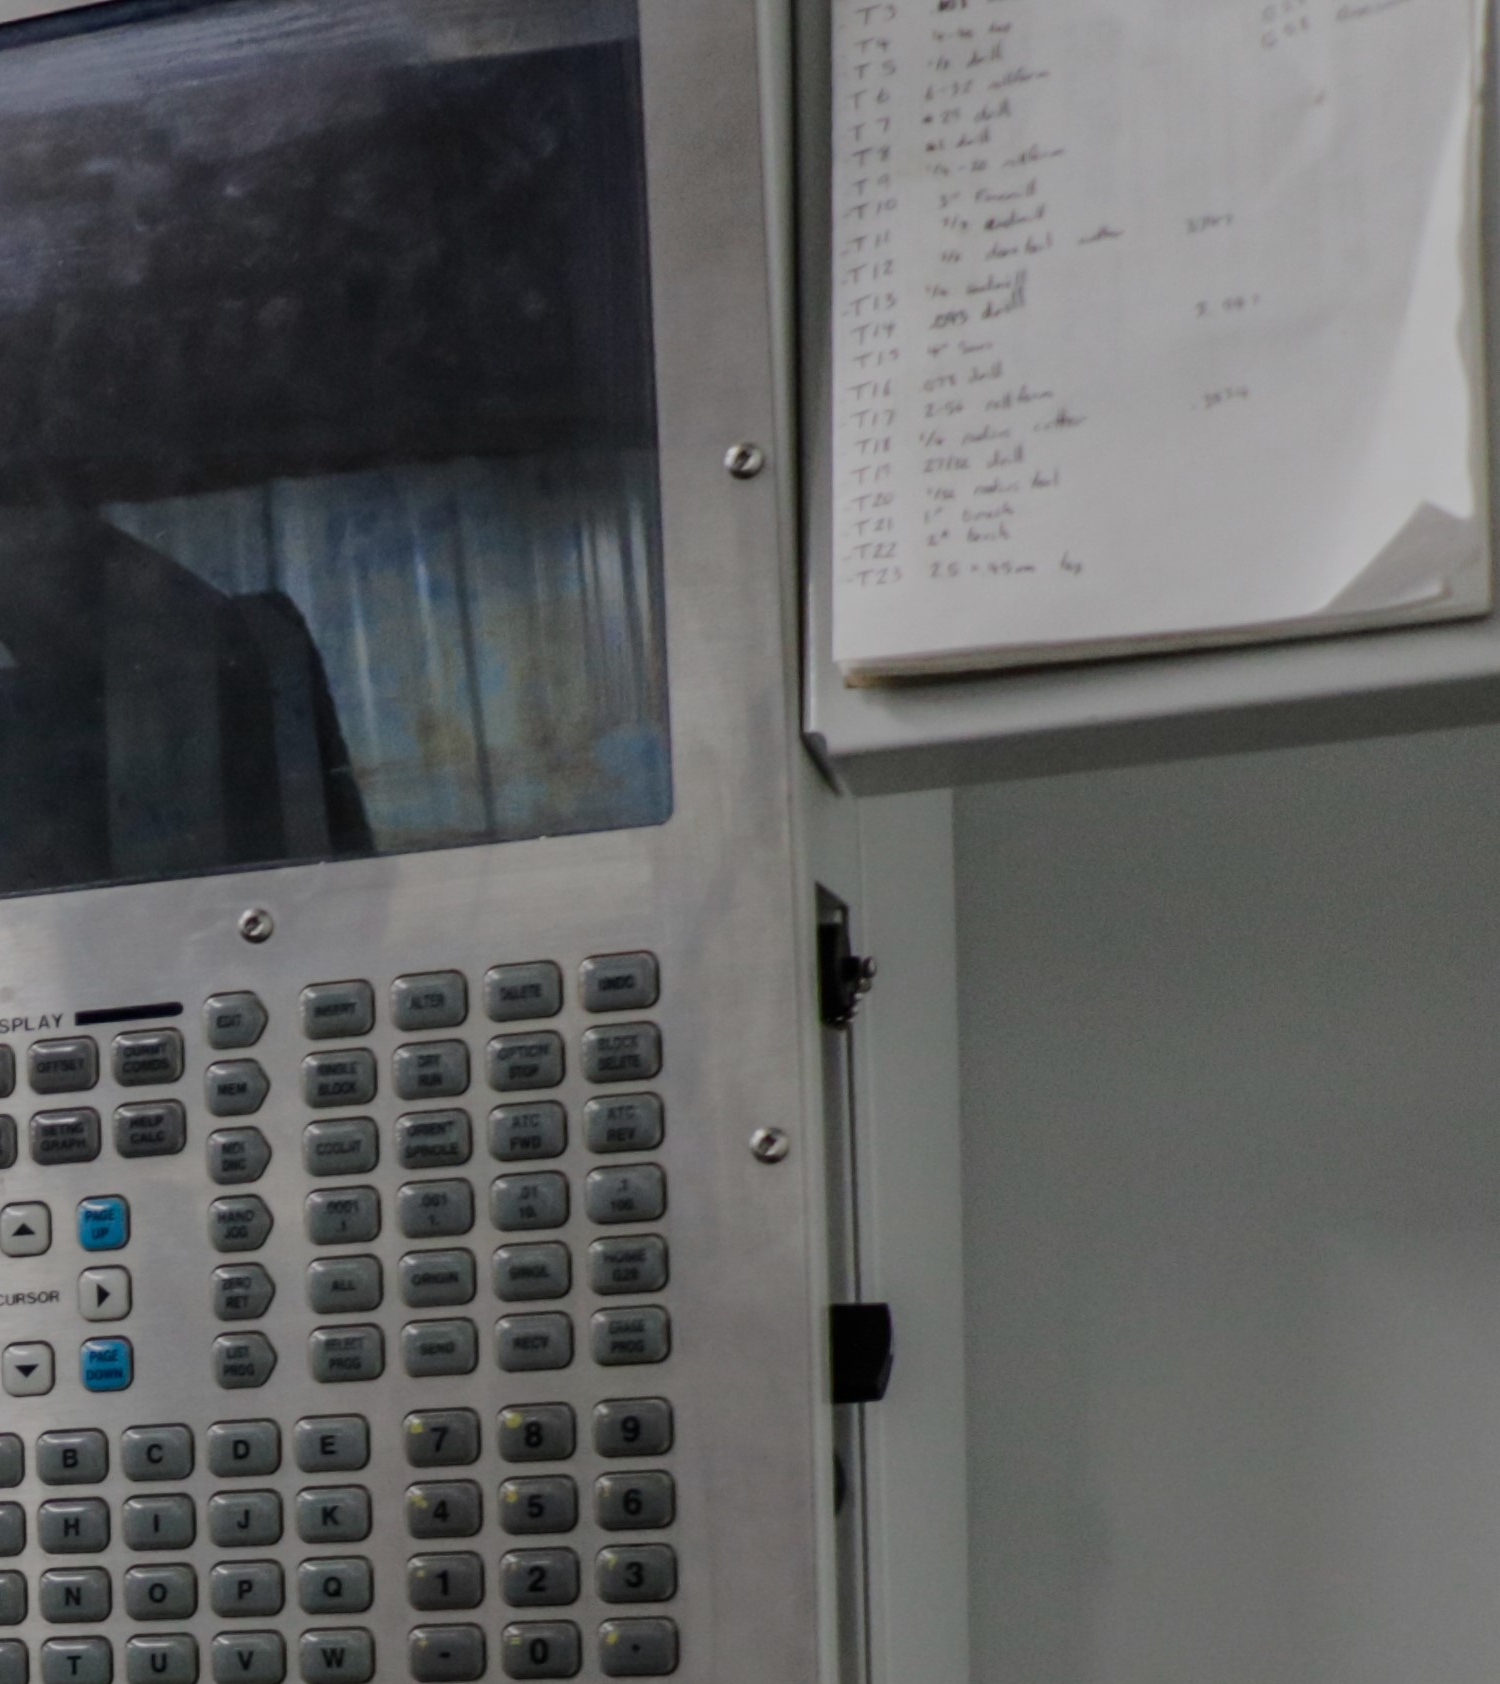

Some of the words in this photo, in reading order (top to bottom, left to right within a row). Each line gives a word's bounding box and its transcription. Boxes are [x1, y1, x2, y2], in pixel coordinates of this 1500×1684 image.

[36, 1058, 84, 1074] OFFSET
[509, 1065, 540, 1079] STOP
[217, 1082, 247, 1096] MEM
[318, 1081, 357, 1096] BLOCK
[129, 1114, 164, 1128] HELP
[512, 1114, 541, 1128] ATC
[510, 1135, 542, 1150] FWD
[607, 1127, 636, 1142] REV
[40, 1137, 86, 1152] GRAPH
[85, 1209, 115, 1221] PAGE
[91, 1228, 109, 1239] UP
[225, 1226, 248, 1239] JOG
[331, 1280, 356, 1292] ALL
[89, 1350, 118, 1362] PAGE
[86, 1368, 123, 1381] DOWN
[524, 1421, 543, 1448] 8
[621, 1416, 641, 1442] 9
[233, 1440, 250, 1459] D
[320, 1435, 336, 1455] E
[431, 1427, 448, 1453] 7
[63, 1449, 78, 1468] B
[146, 1443, 163, 1464] C
[527, 1494, 544, 1518] 5
[623, 1488, 642, 1515] 6
[237, 1509, 249, 1530] J
[322, 1505, 339, 1526] K
[433, 1501, 449, 1523] 4
[63, 1517, 80, 1537] H
[153, 1514, 159, 1533] I
[436, 1570, 449, 1597] 1
[527, 1566, 546, 1592] 2
[625, 1562, 644, 1588] 3
[149, 1584, 167, 1603] O
[238, 1580, 253, 1599] P
[323, 1576, 342, 1597] Q
[65, 1587, 81, 1606] N
[238, 1651, 254, 1671] V
[320, 1648, 345, 1668] W
[529, 1638, 549, 1665] 0
[67, 1656, 82, 1675] T
[151, 1654, 167, 1673] U
